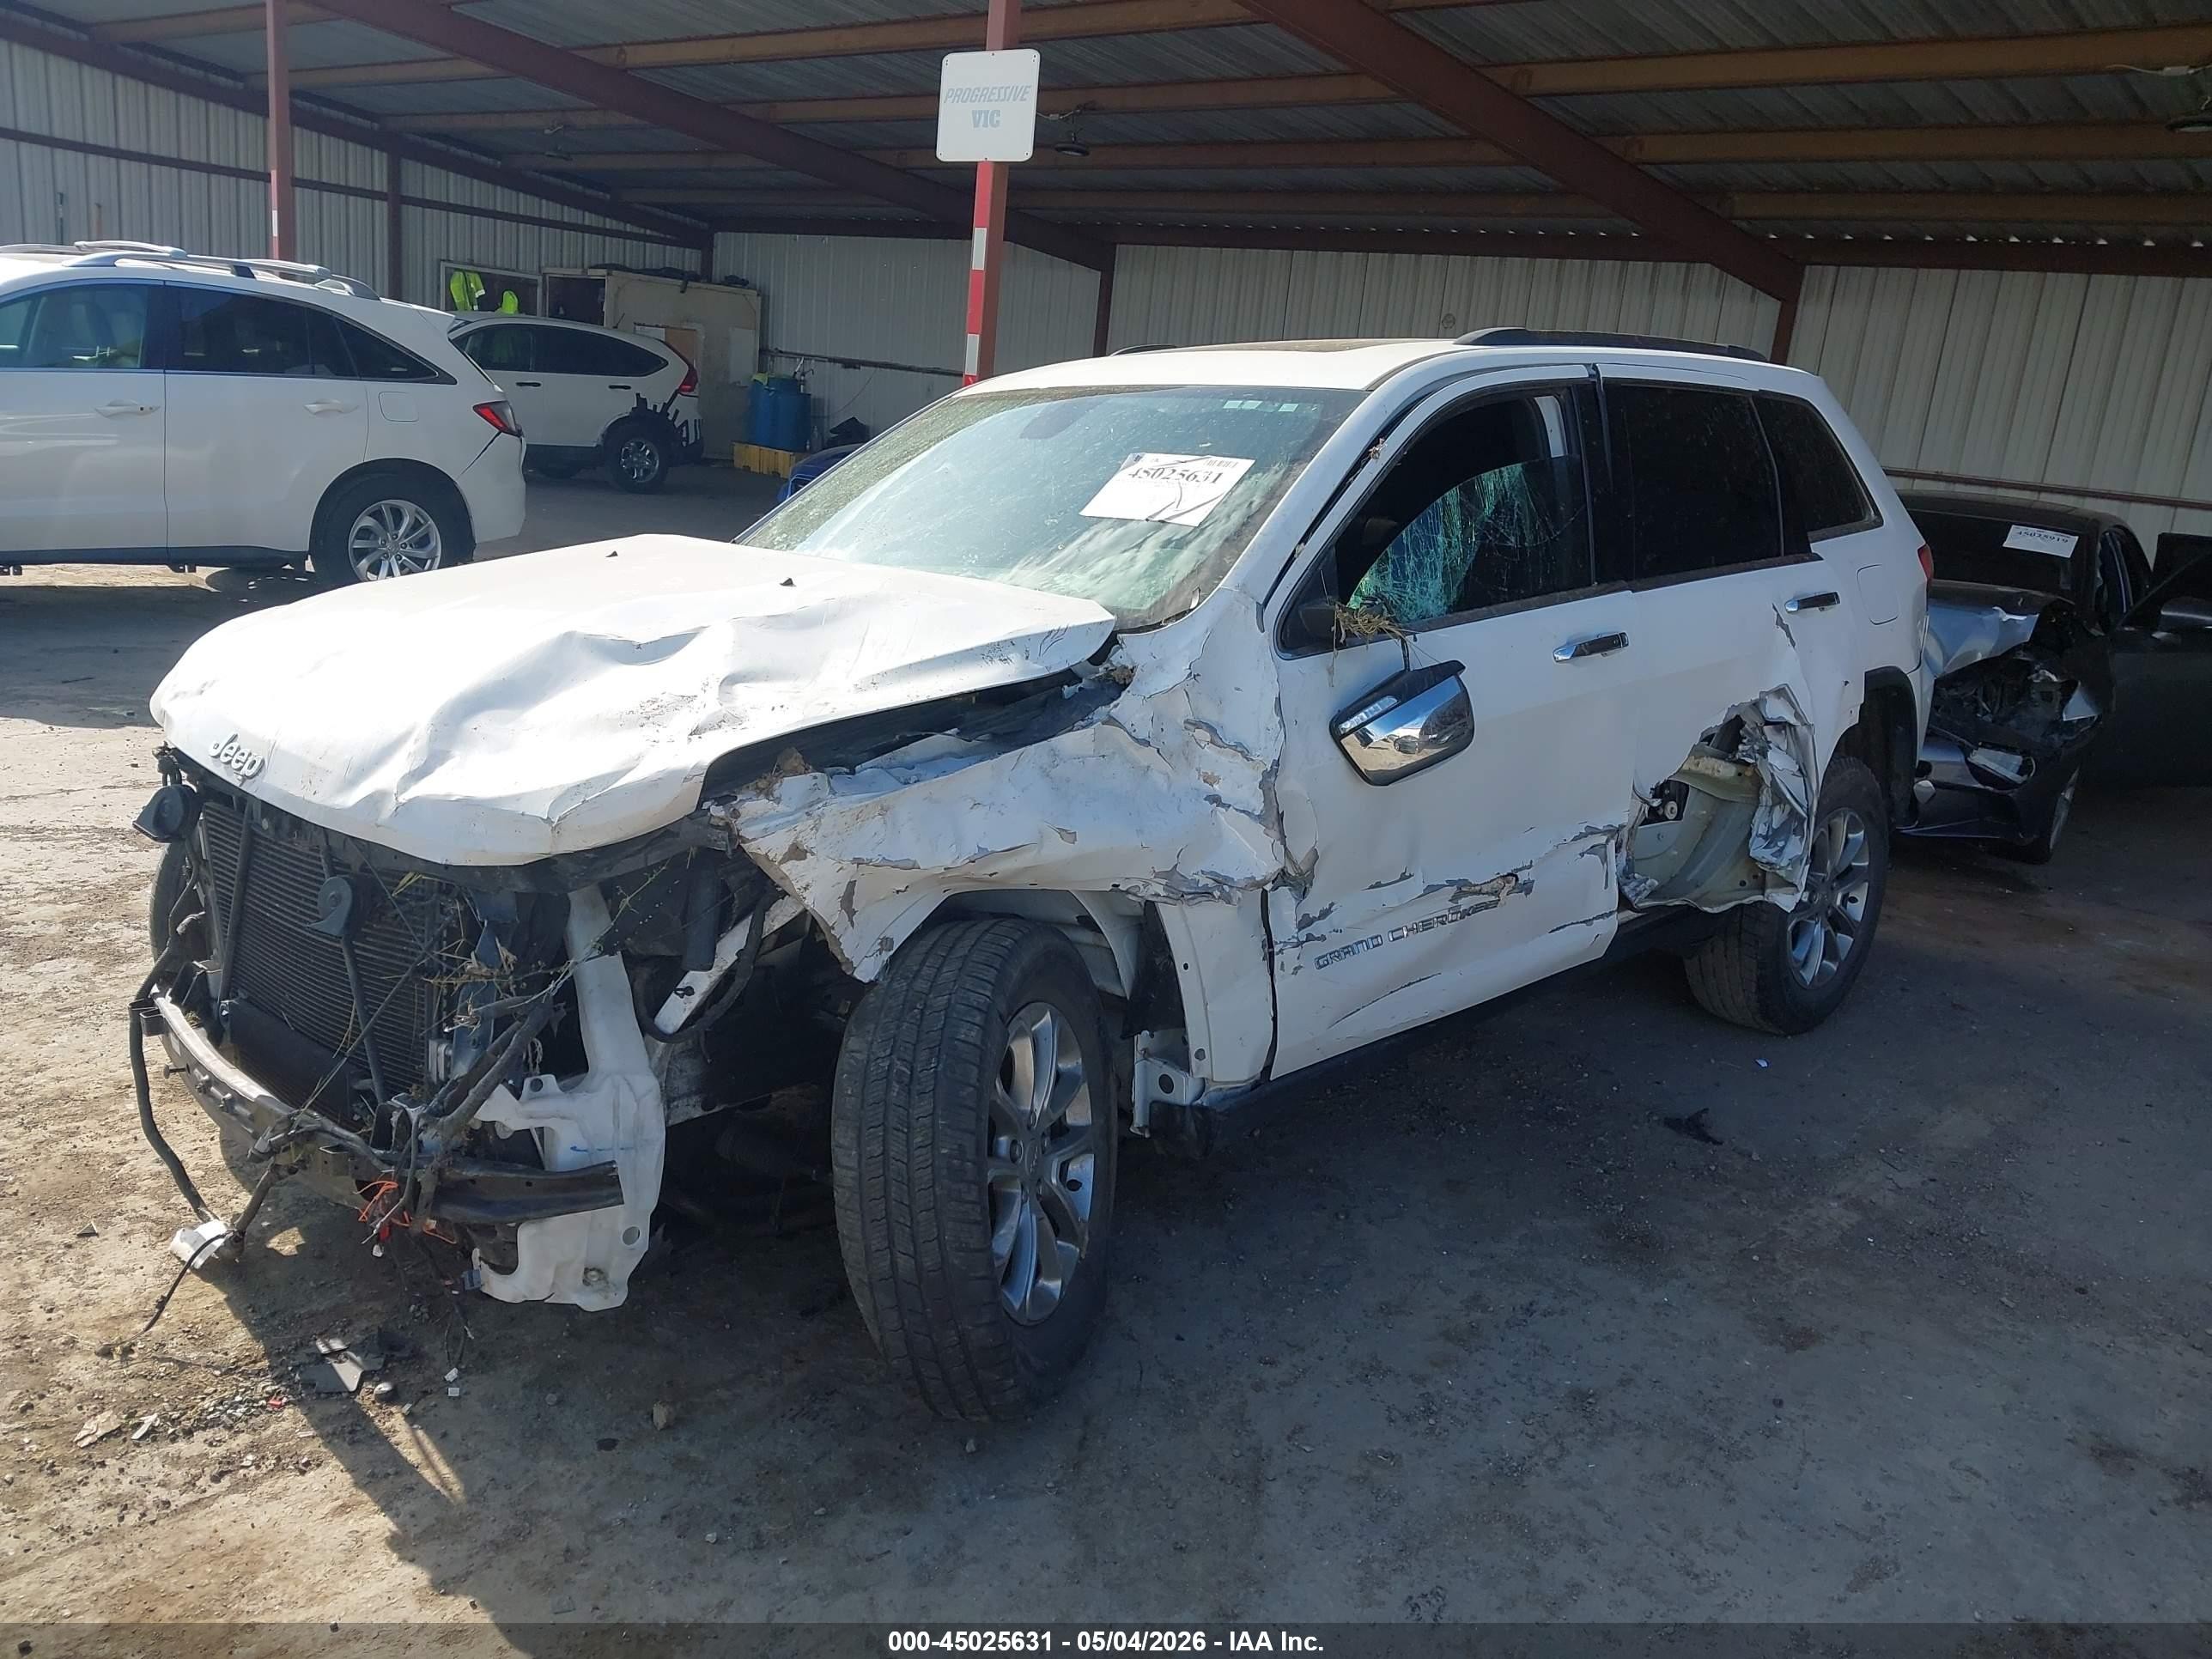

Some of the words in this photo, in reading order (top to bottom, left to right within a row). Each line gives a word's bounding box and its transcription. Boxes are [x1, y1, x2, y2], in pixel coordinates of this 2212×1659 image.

[945, 85, 1032, 104] PROGRESSIVE
[971, 109, 1001, 128] VIC
[1128, 467, 1224, 484] 45025631
[209, 732, 265, 785] Jeep
[1315, 933, 1383, 970] GRAND
